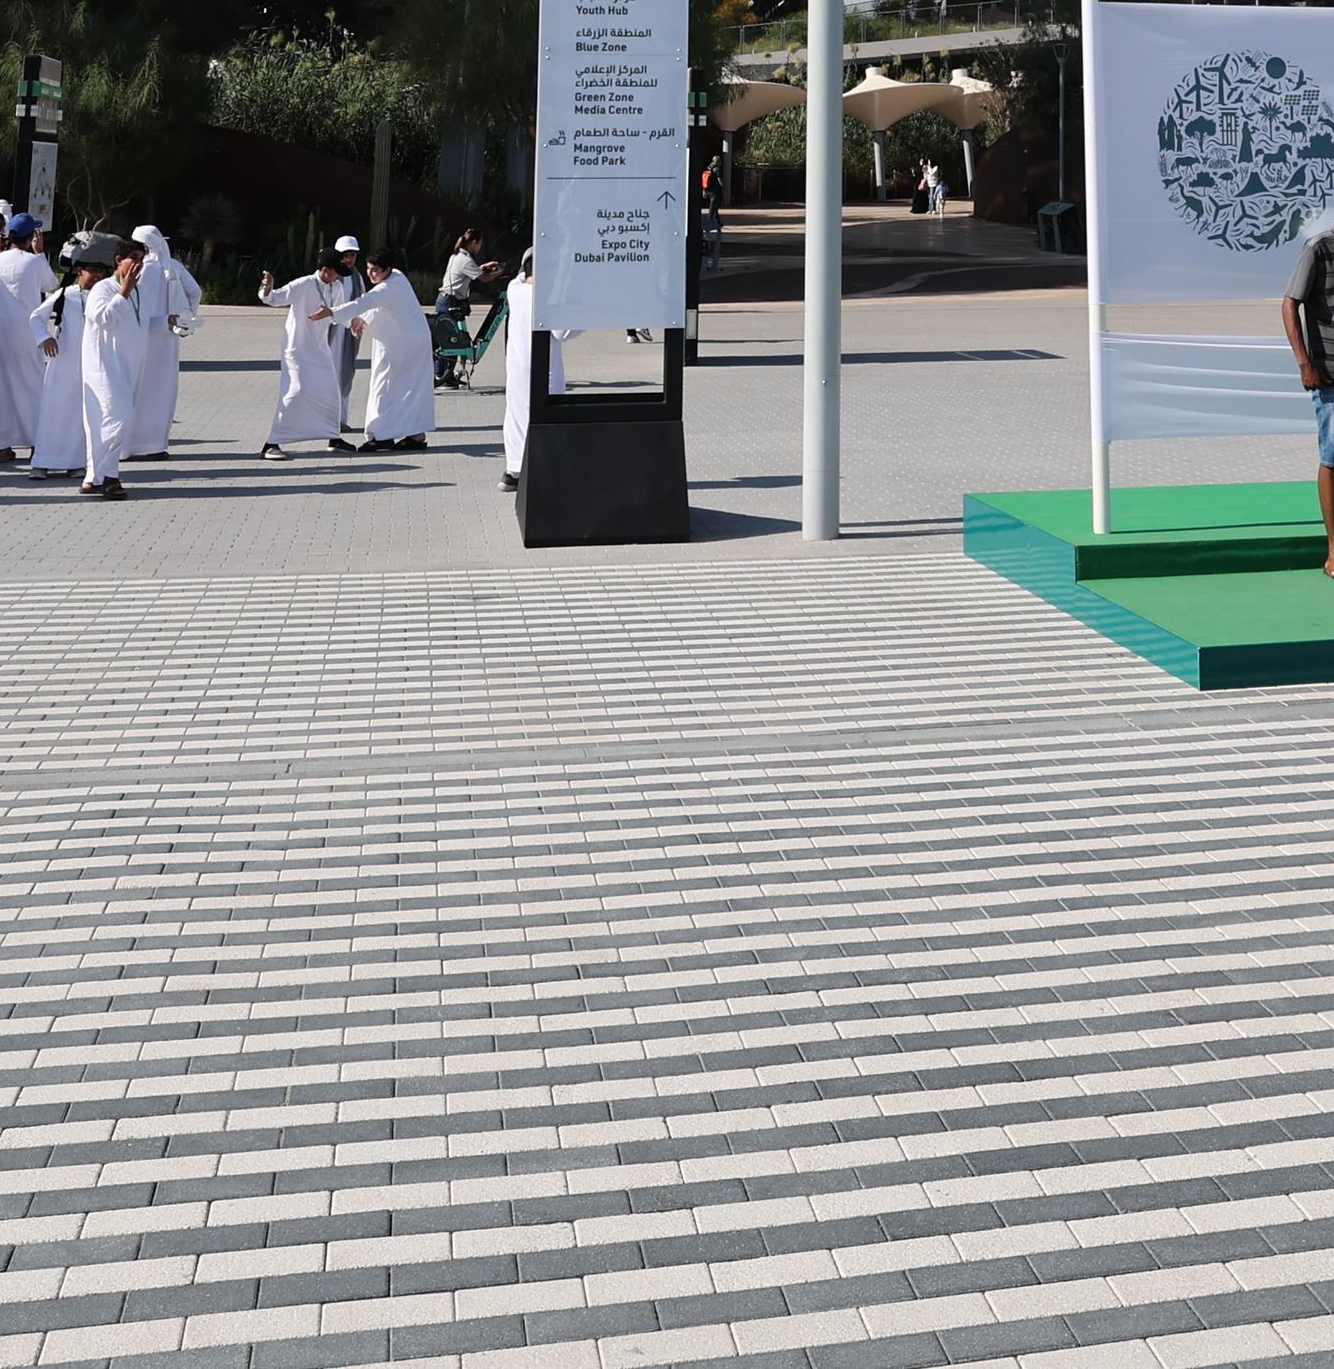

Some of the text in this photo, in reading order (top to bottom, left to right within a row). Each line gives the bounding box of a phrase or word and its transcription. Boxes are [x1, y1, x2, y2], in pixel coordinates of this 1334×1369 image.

[576, 5, 629, 15] Youth Hub
[576, 28, 652, 40] المنطقة الزرقاء
[575, 42, 627, 52] Blue Zone
[575, 65, 647, 78] المركز الإعلامي
[575, 78, 658, 90] للمنطقة الخضراء
[574, 92, 635, 102] Green Zone
[574, 105, 644, 115] Media Centre
[573, 128, 609, 140] الطعام
[611, 128, 640, 137] ساحة
[649, 128, 675, 141] القرم
[573, 143, 626, 155] Mangrove
[573, 156, 626, 166] Food Park
[596, 208, 650, 223] جناح مدينة
[597, 222, 650, 237] إكسبو دبي
[601, 239, 650, 252] Expo City
[574, 252, 650, 263] Dubai Pavilion
